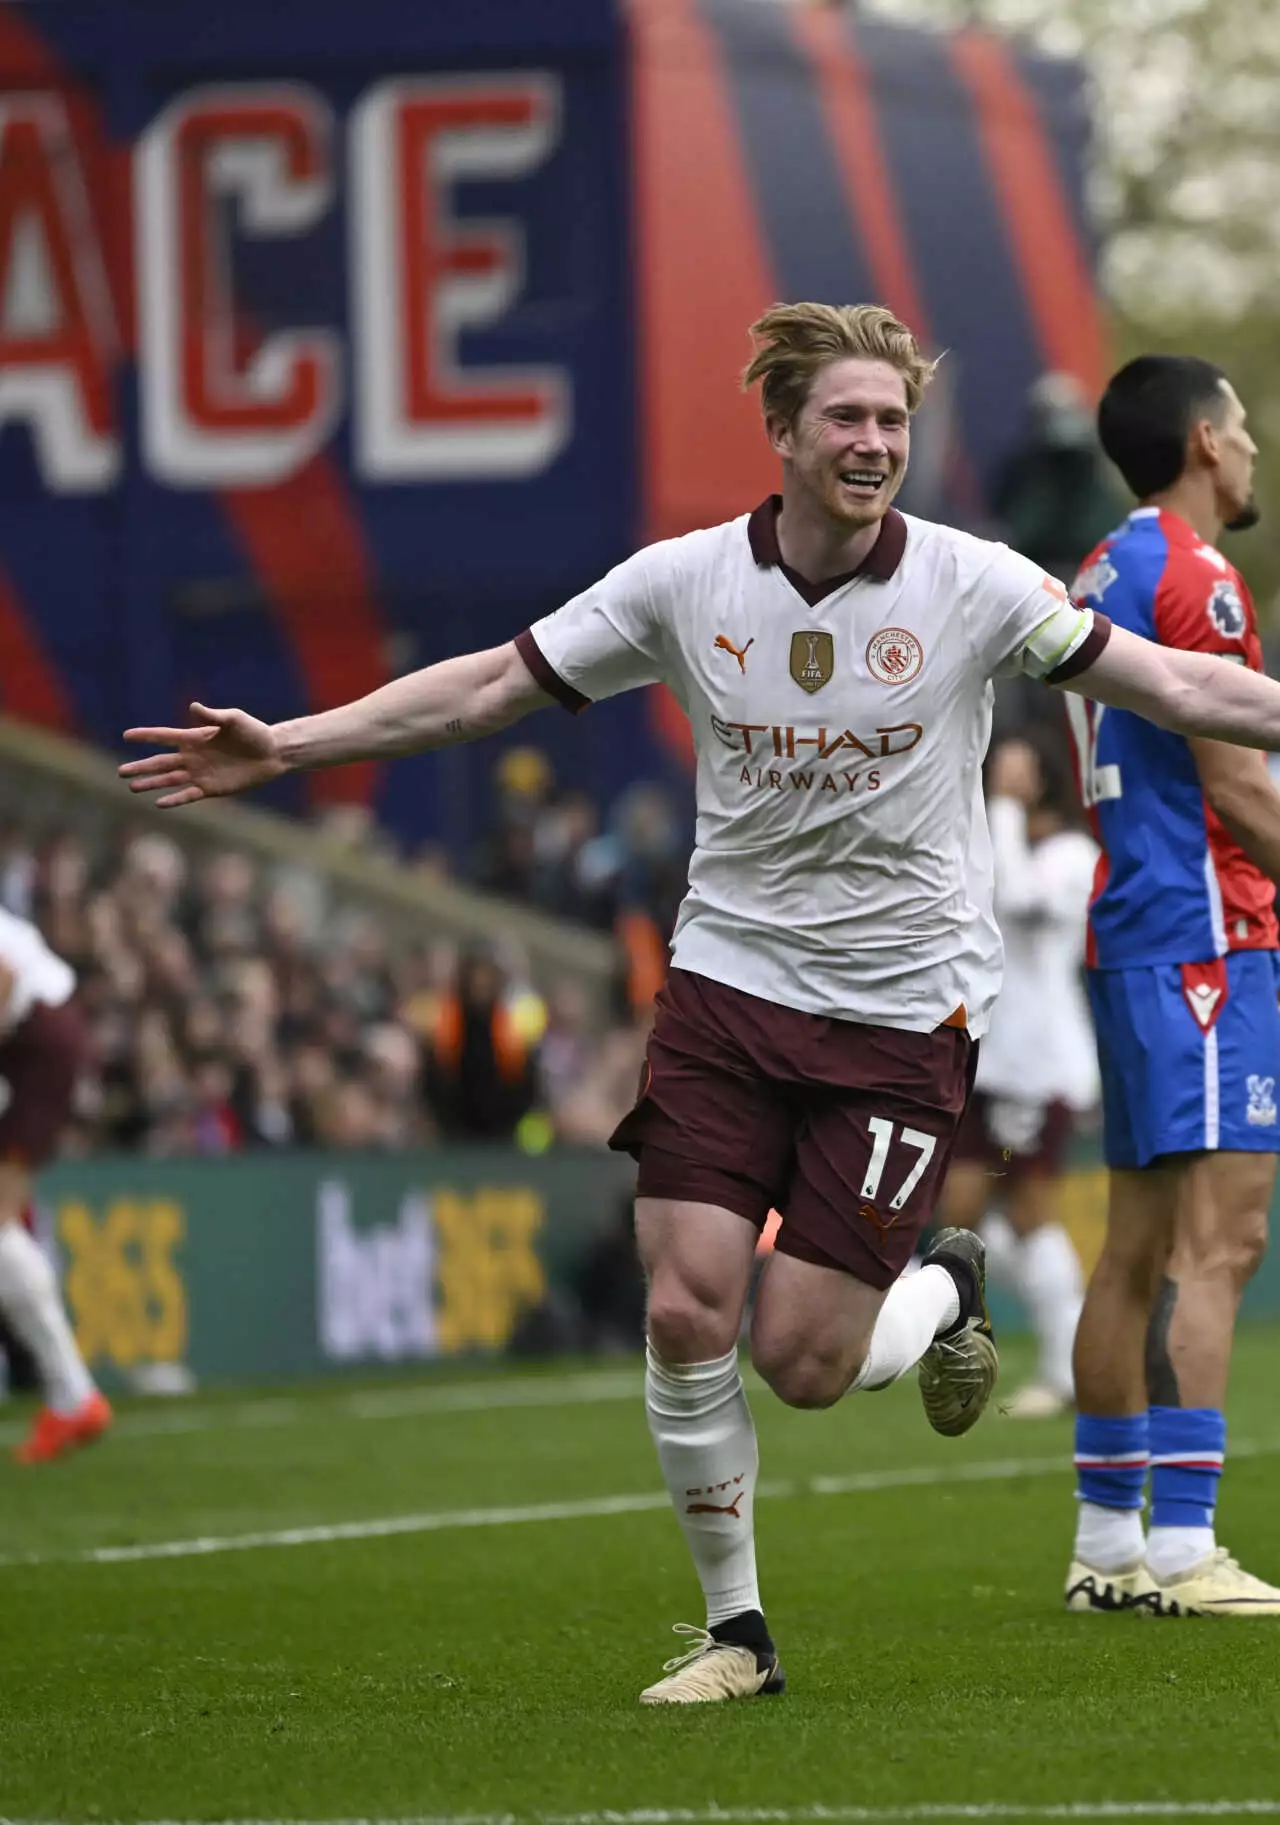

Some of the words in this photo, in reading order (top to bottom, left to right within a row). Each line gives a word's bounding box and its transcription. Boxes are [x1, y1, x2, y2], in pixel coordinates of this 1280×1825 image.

[0, 71, 571, 492] ACE
[801, 669, 823, 678] FIFA
[710, 714, 923, 760] ETIHAD
[739, 765, 882, 791] AIRWAYS
[860, 1116, 937, 1210] 17
